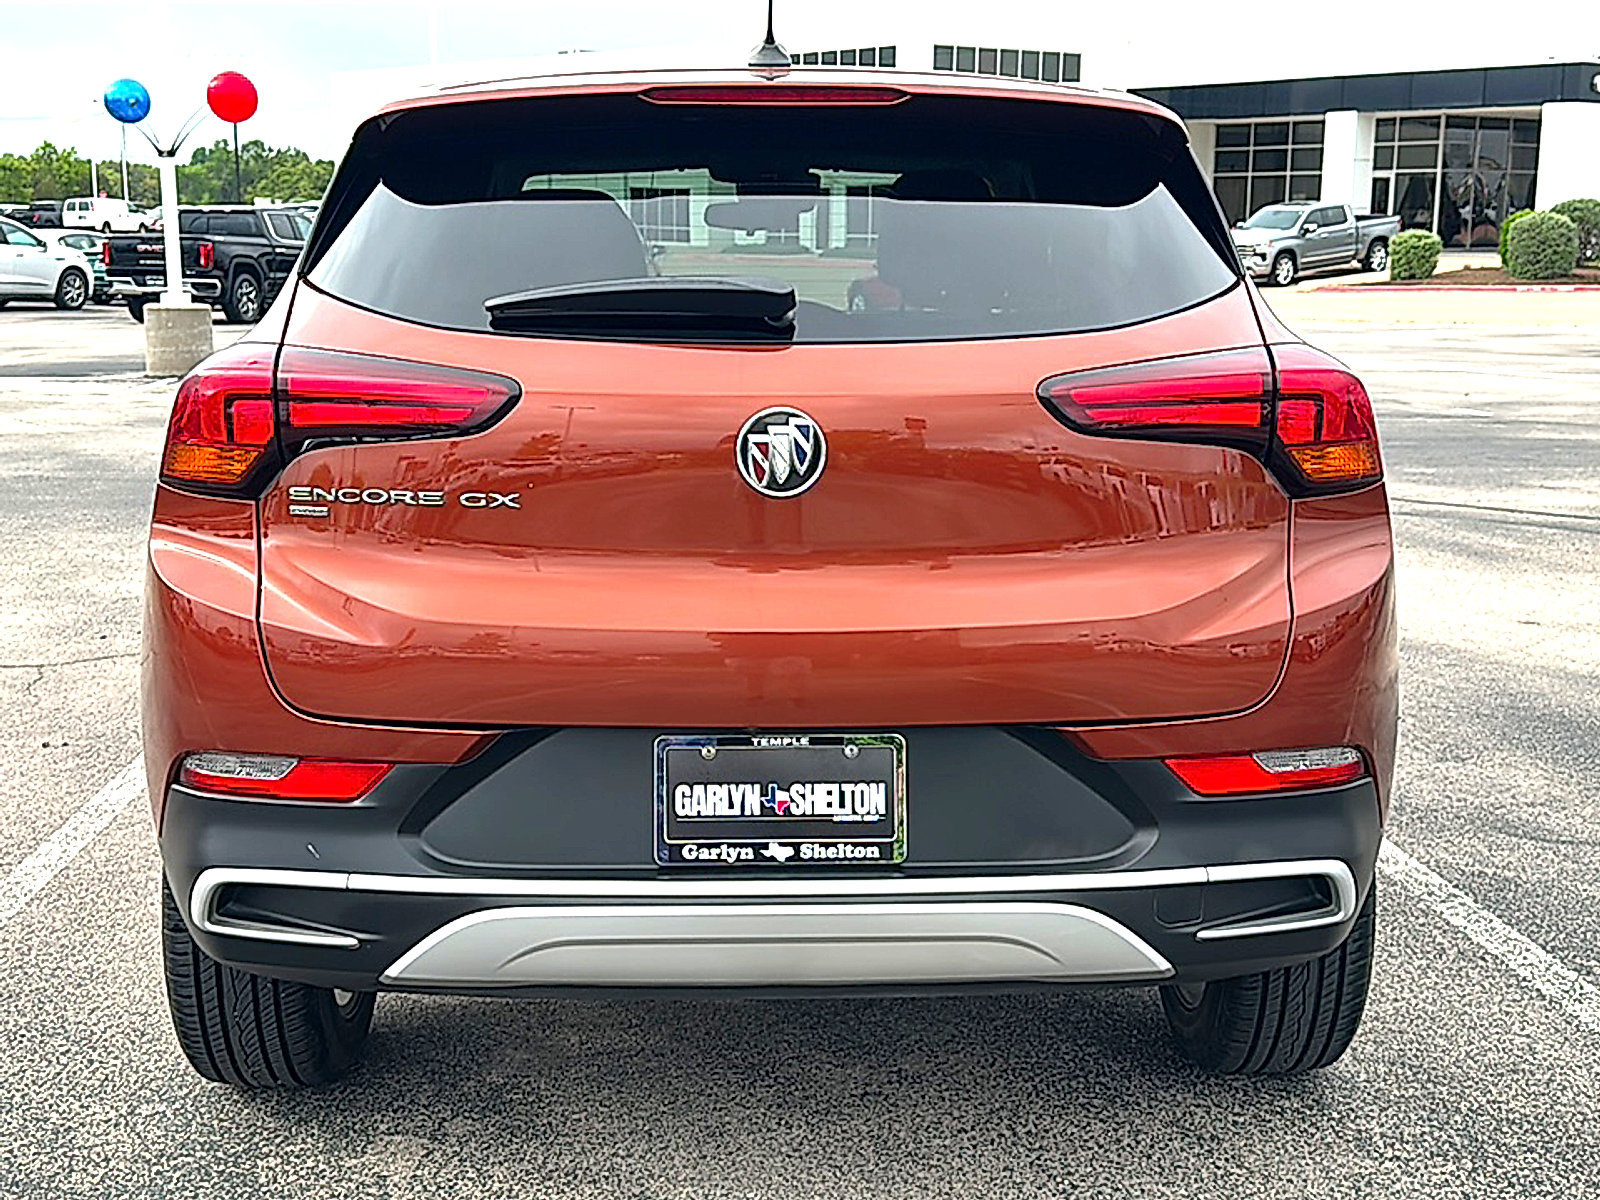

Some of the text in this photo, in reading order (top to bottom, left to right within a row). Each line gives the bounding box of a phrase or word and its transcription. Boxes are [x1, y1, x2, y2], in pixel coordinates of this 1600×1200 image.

[288, 486, 522, 508] ENCORE GX
[751, 737, 810, 747] TEMPLE
[674, 782, 887, 817] GARLYN SHELTON
[681, 843, 881, 864] Garlyn Shelton
